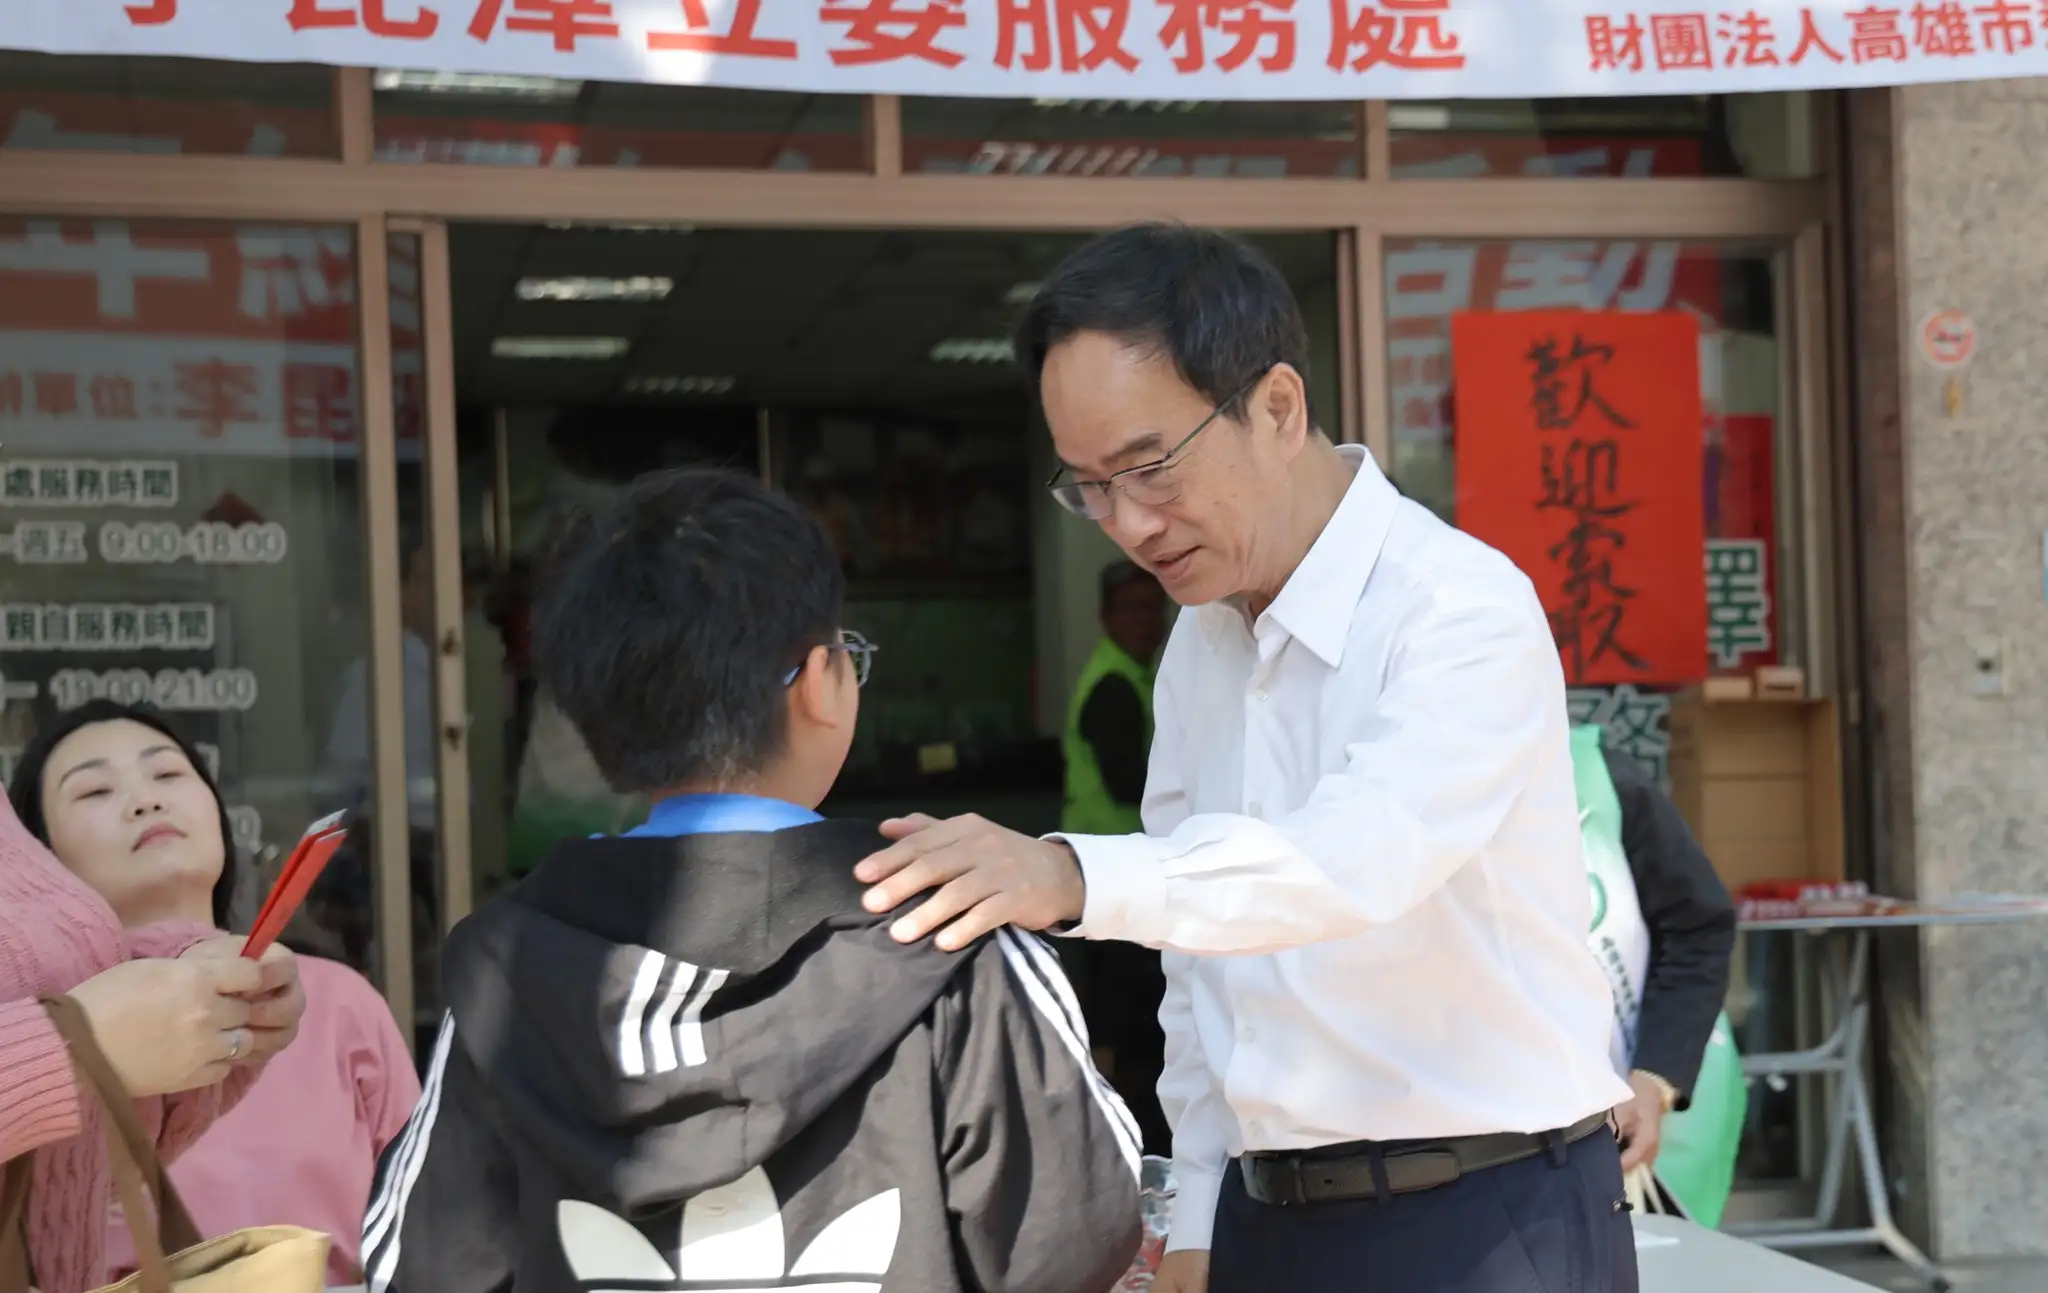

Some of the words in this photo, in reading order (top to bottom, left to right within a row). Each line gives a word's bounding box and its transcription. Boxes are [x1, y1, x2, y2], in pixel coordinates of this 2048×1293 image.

[1585, 0, 2048, 73] 財團法人高雄市
[1520, 333, 1655, 684] 歡迎索取
